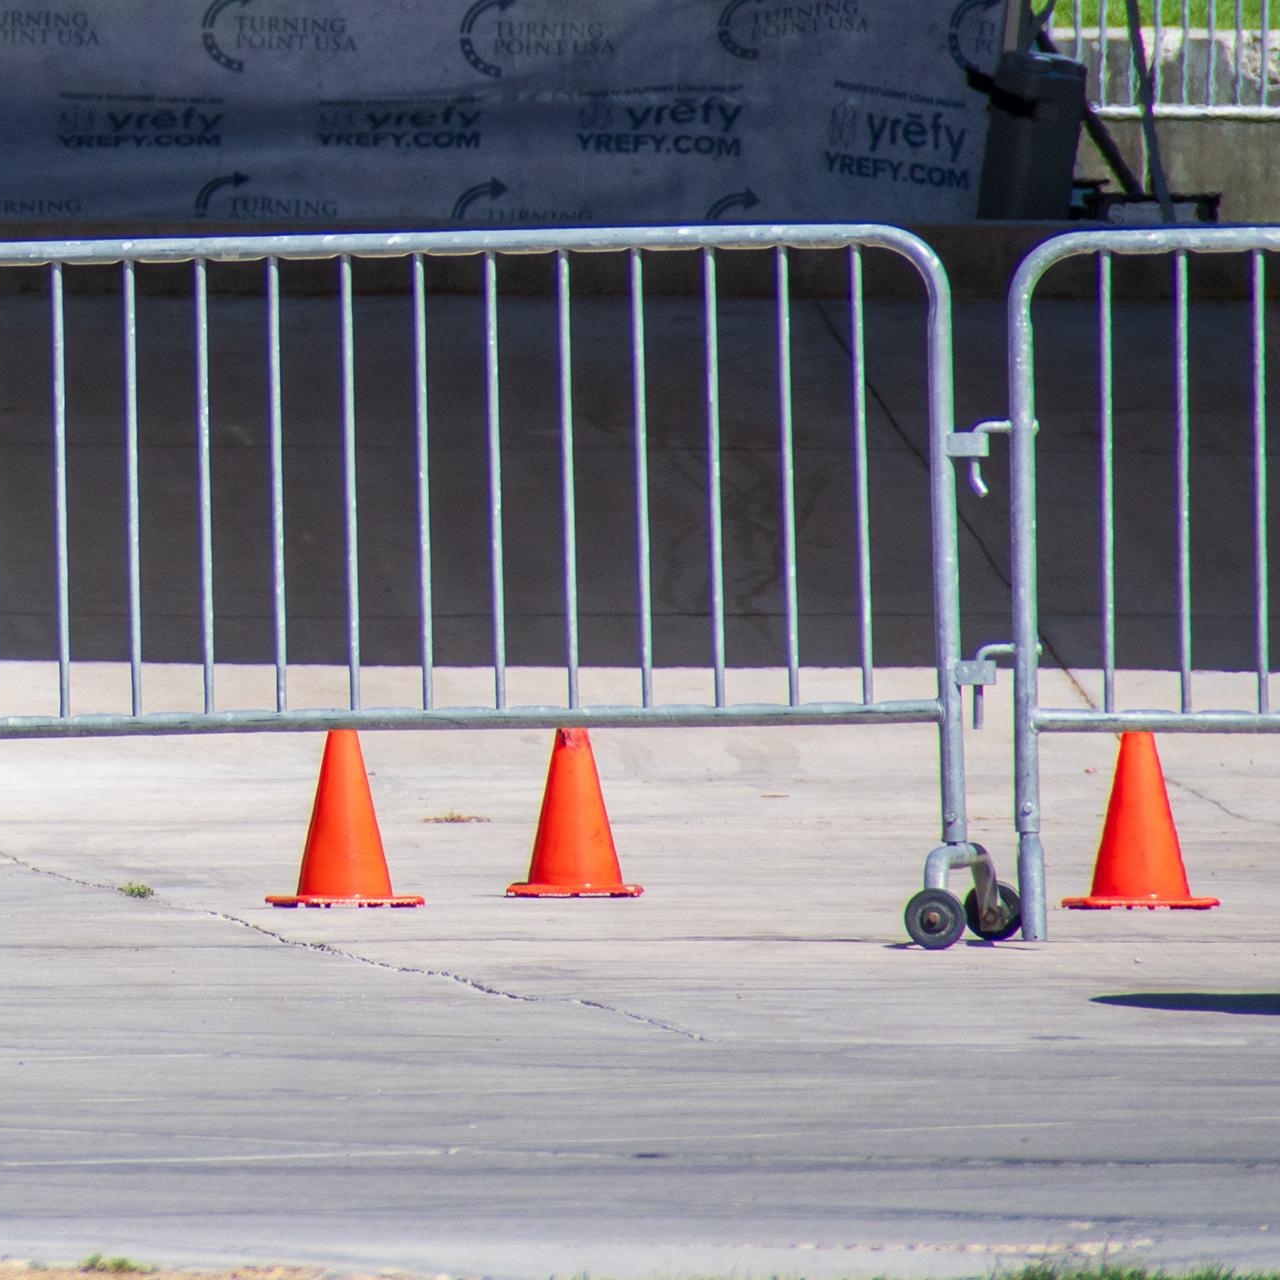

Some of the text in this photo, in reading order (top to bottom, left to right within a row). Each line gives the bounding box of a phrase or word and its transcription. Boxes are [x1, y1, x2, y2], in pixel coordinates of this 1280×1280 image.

[751, 0, 860, 24] TURNING
[234, 15, 347, 35] TURNING
[491, 21, 606, 40] TURNING
[751, 15, 870, 42] POINT USA
[56, 26, 100, 47] USA
[235, 32, 358, 52] POINT USA
[492, 37, 616, 57] POINT USA
[57, 133, 221, 148] YREFY.COM
[318, 131, 481, 148] YREFY.COM
[576, 132, 741, 157] YREFY.COM
[824, 150, 970, 190] YREFY.COM
[226, 195, 339, 218] TURNING
